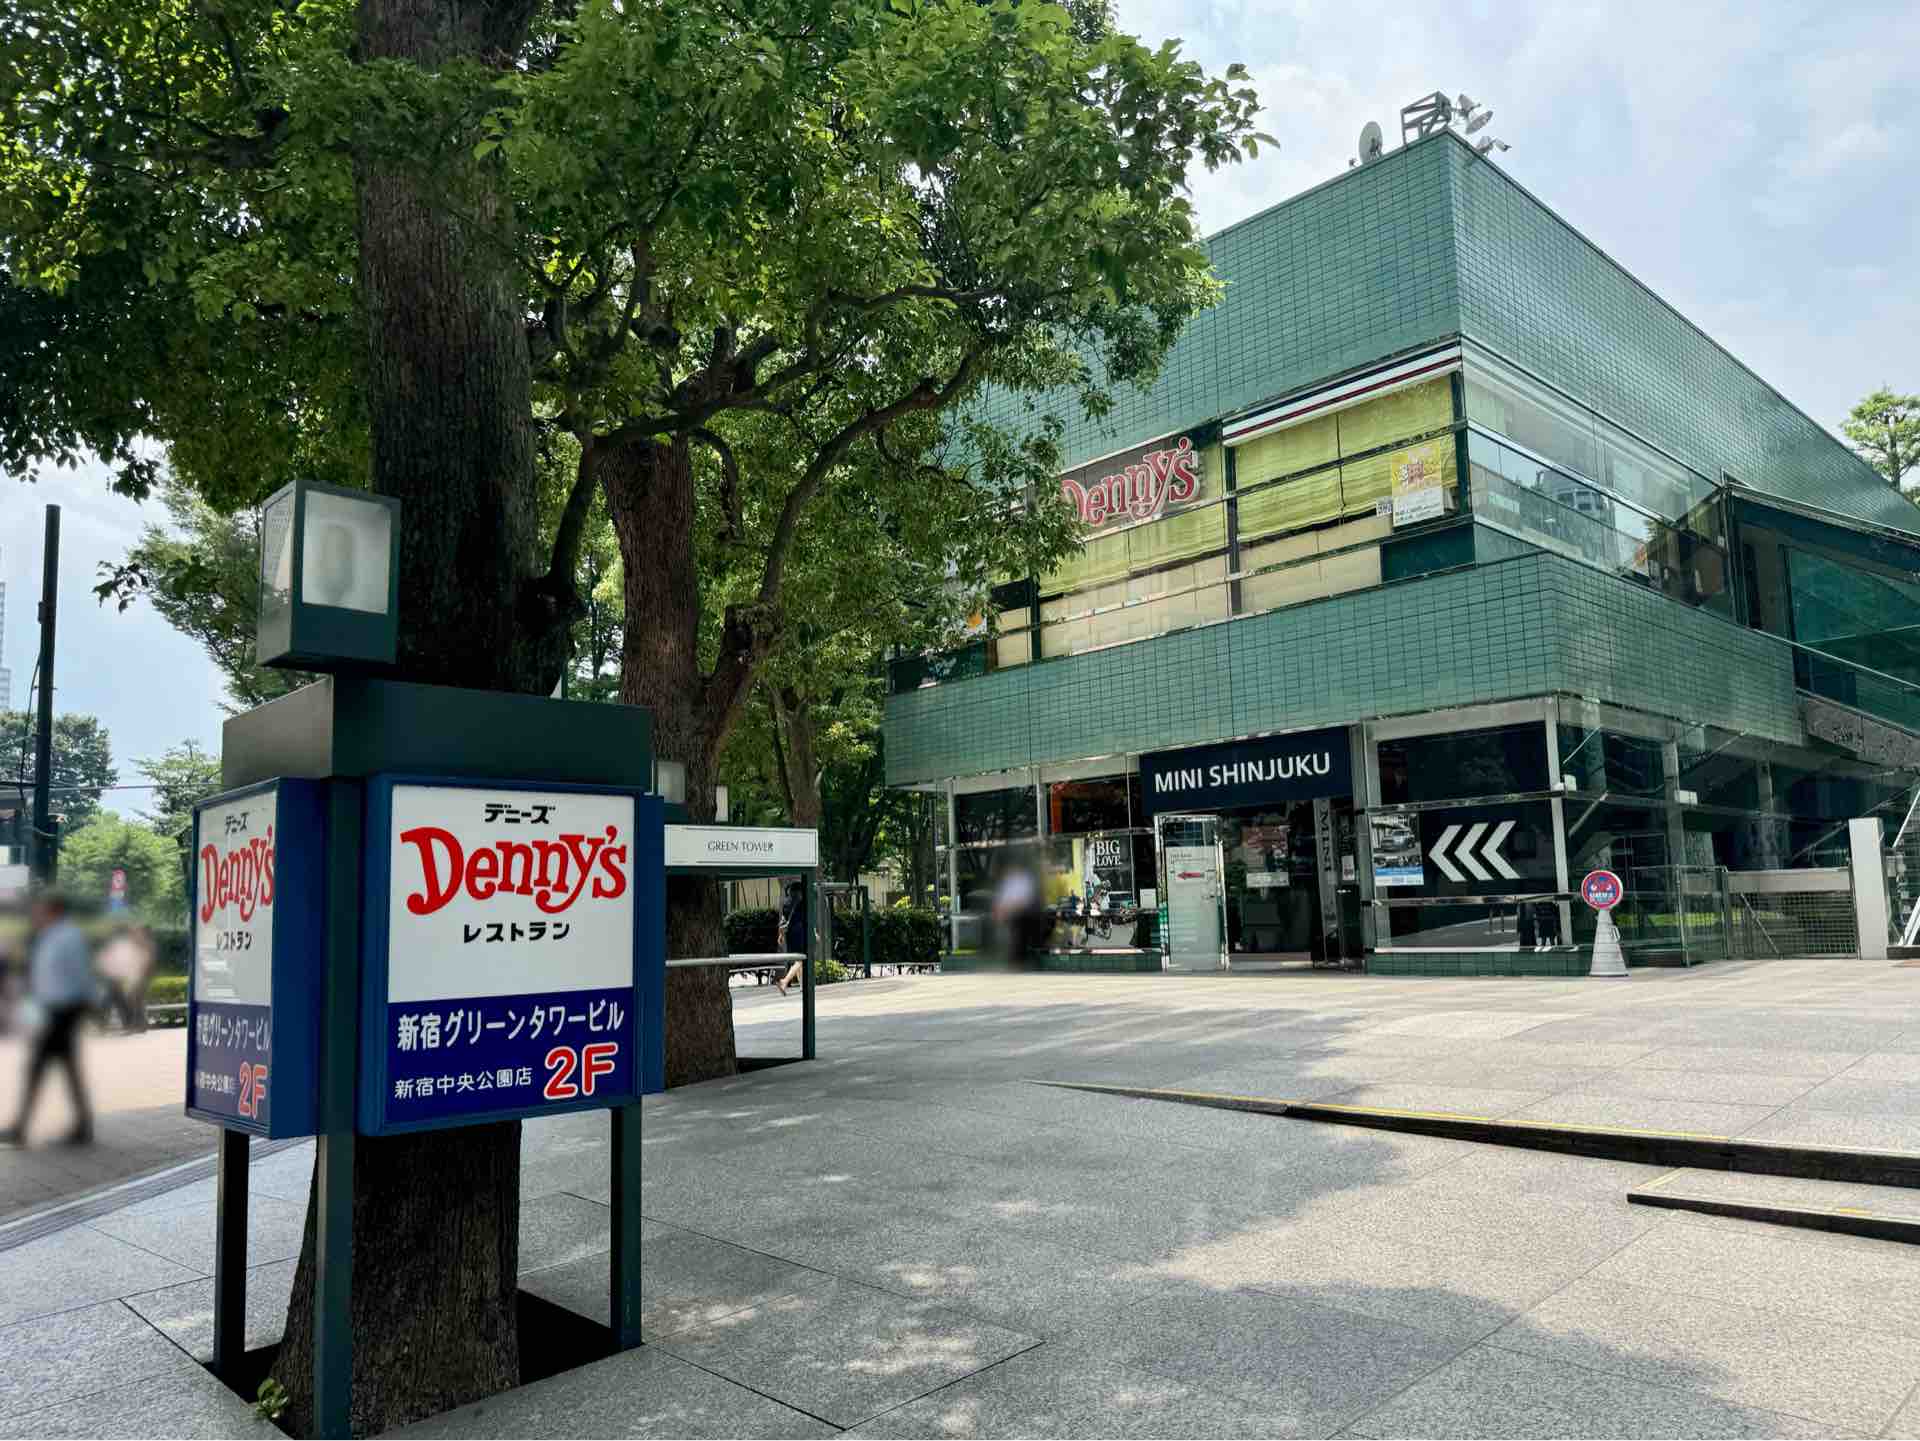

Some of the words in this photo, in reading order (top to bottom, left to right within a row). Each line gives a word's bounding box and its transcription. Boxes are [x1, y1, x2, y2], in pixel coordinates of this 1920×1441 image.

[1154, 767, 1203, 793] MINI
[1208, 752, 1330, 787] SHINJUKU
[225, 812, 248, 834] デニーズ
[484, 803, 555, 824] デニーズ
[707, 840, 739, 851] GREEN
[742, 841, 774, 852] TOWER
[1096, 840, 1120, 856] BIG
[201, 824, 274, 923] Denny's
[400, 825, 627, 916] Denny's
[216, 932, 252, 950] レストラン
[464, 921, 570, 943] レストラン
[397, 1000, 625, 1051] 新宿グリーンタワービル
[395, 1067, 532, 1099] 新宿中央公園店
[544, 1042, 619, 1100] 2F
[239, 1061, 268, 1120] 2F
